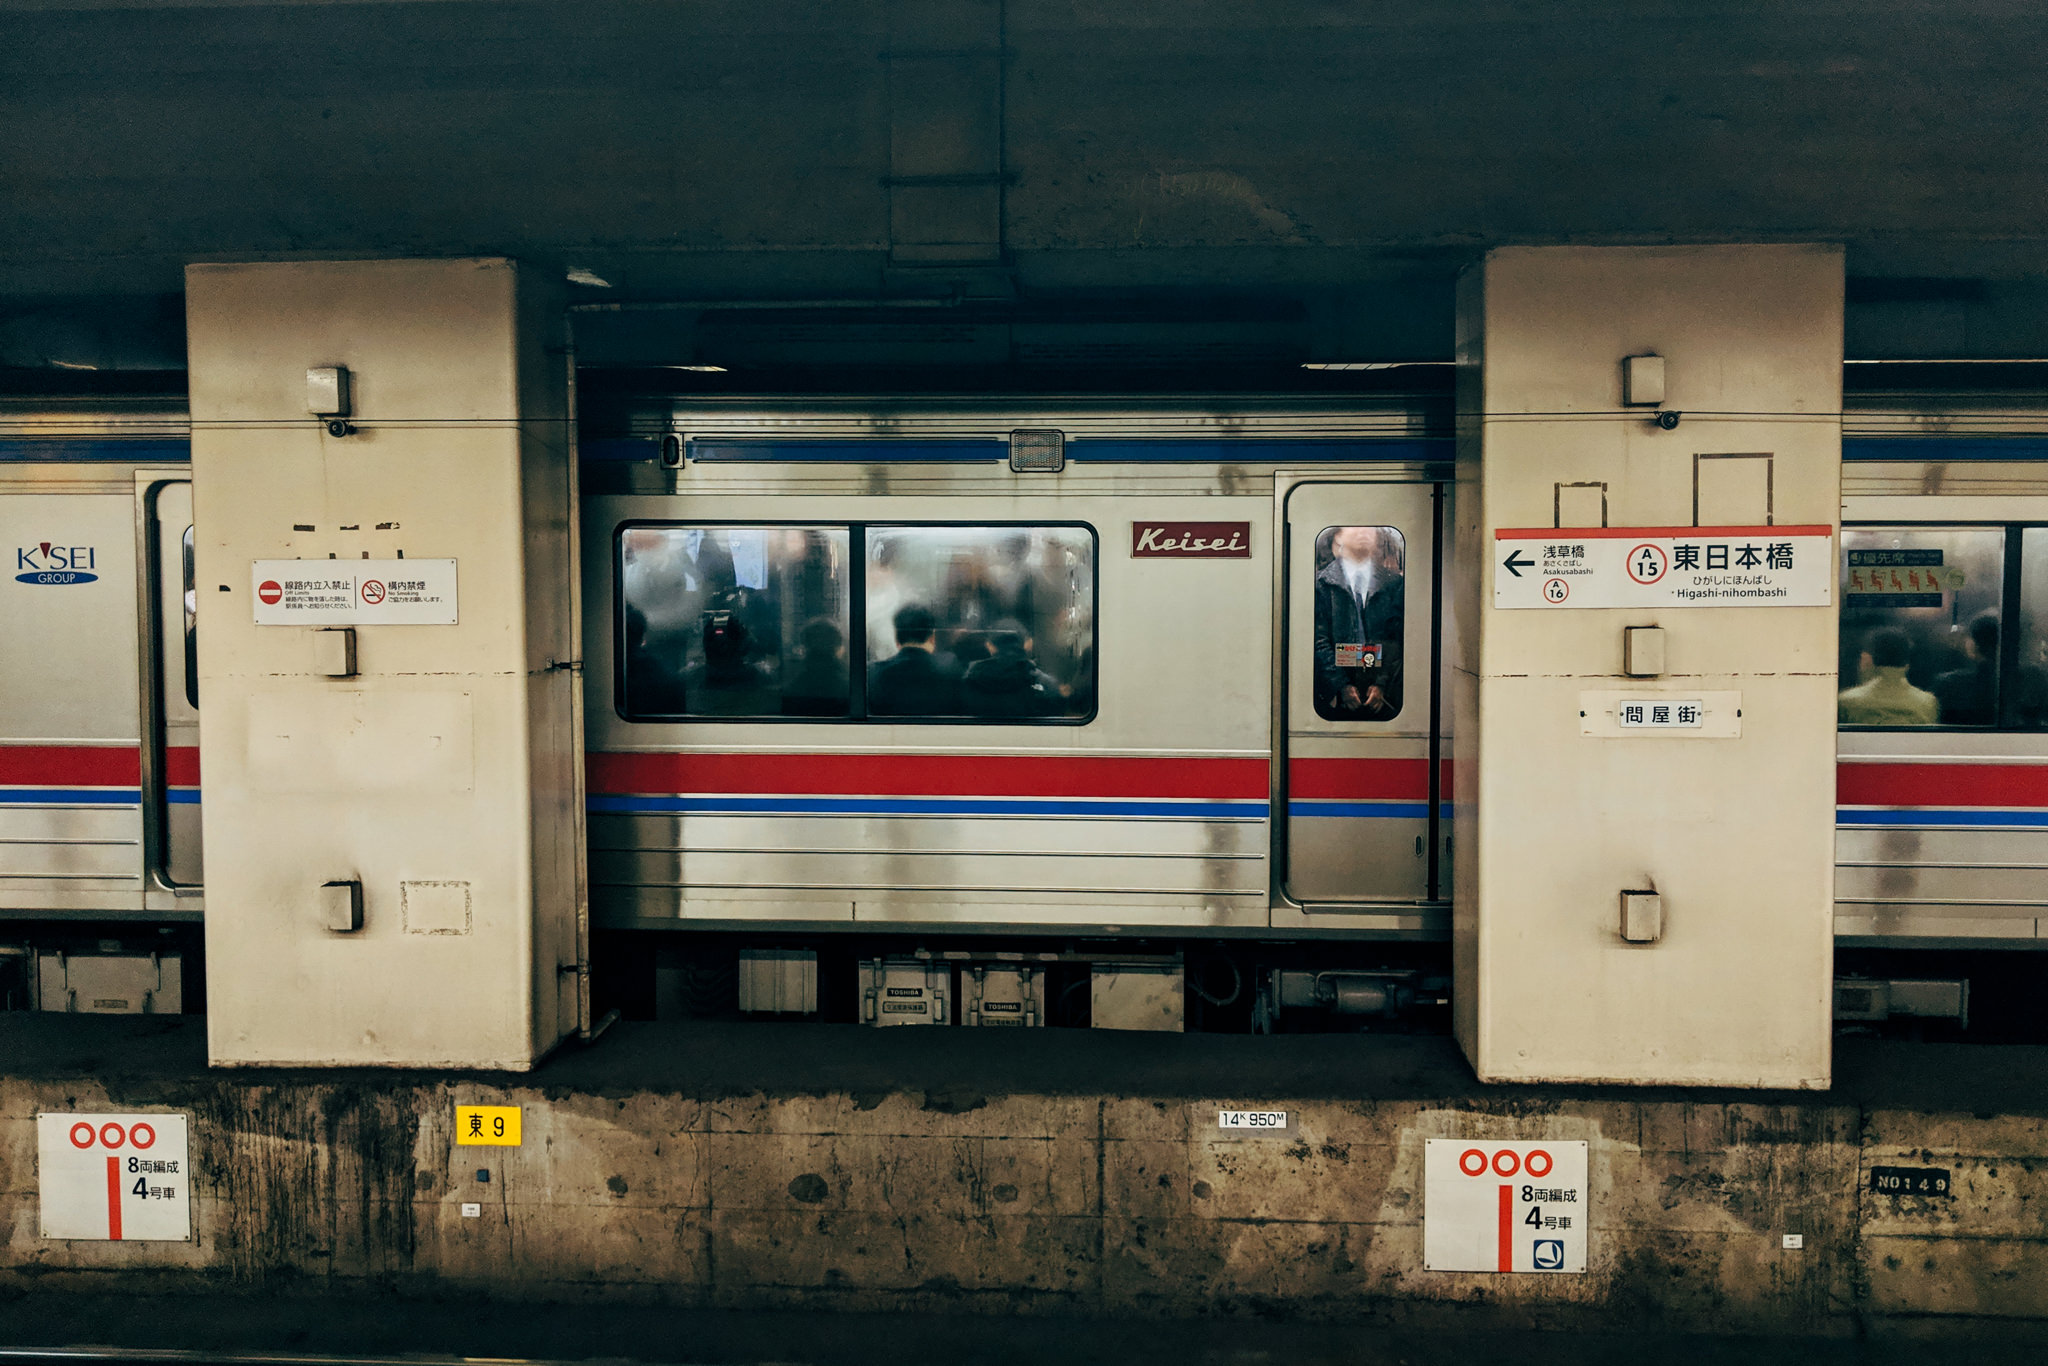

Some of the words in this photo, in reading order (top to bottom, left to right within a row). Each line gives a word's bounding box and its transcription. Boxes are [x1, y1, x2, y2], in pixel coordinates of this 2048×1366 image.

[1136, 528, 1247, 551] Keisei
[1543, 545, 1585, 559] 浅草橋
[1641, 548, 1652, 560] A
[1673, 543, 1794, 571] 東日本橋
[1637, 562, 1658, 577] 15
[37, 573, 76, 583] GROUP
[285, 581, 351, 590] 線路内立入禁止
[388, 581, 426, 591] 構内禁煙
[1677, 587, 1787, 600] Higashi-nihombashi
[1550, 589, 1564, 599] 16
[1625, 706, 1696, 724] 問屋街
[128, 1157, 179, 1174] 8両編成
[132, 1177, 176, 1200] 4号車
[1521, 1185, 1577, 1203] 8両編成
[1525, 1206, 1572, 1230] 4号車
